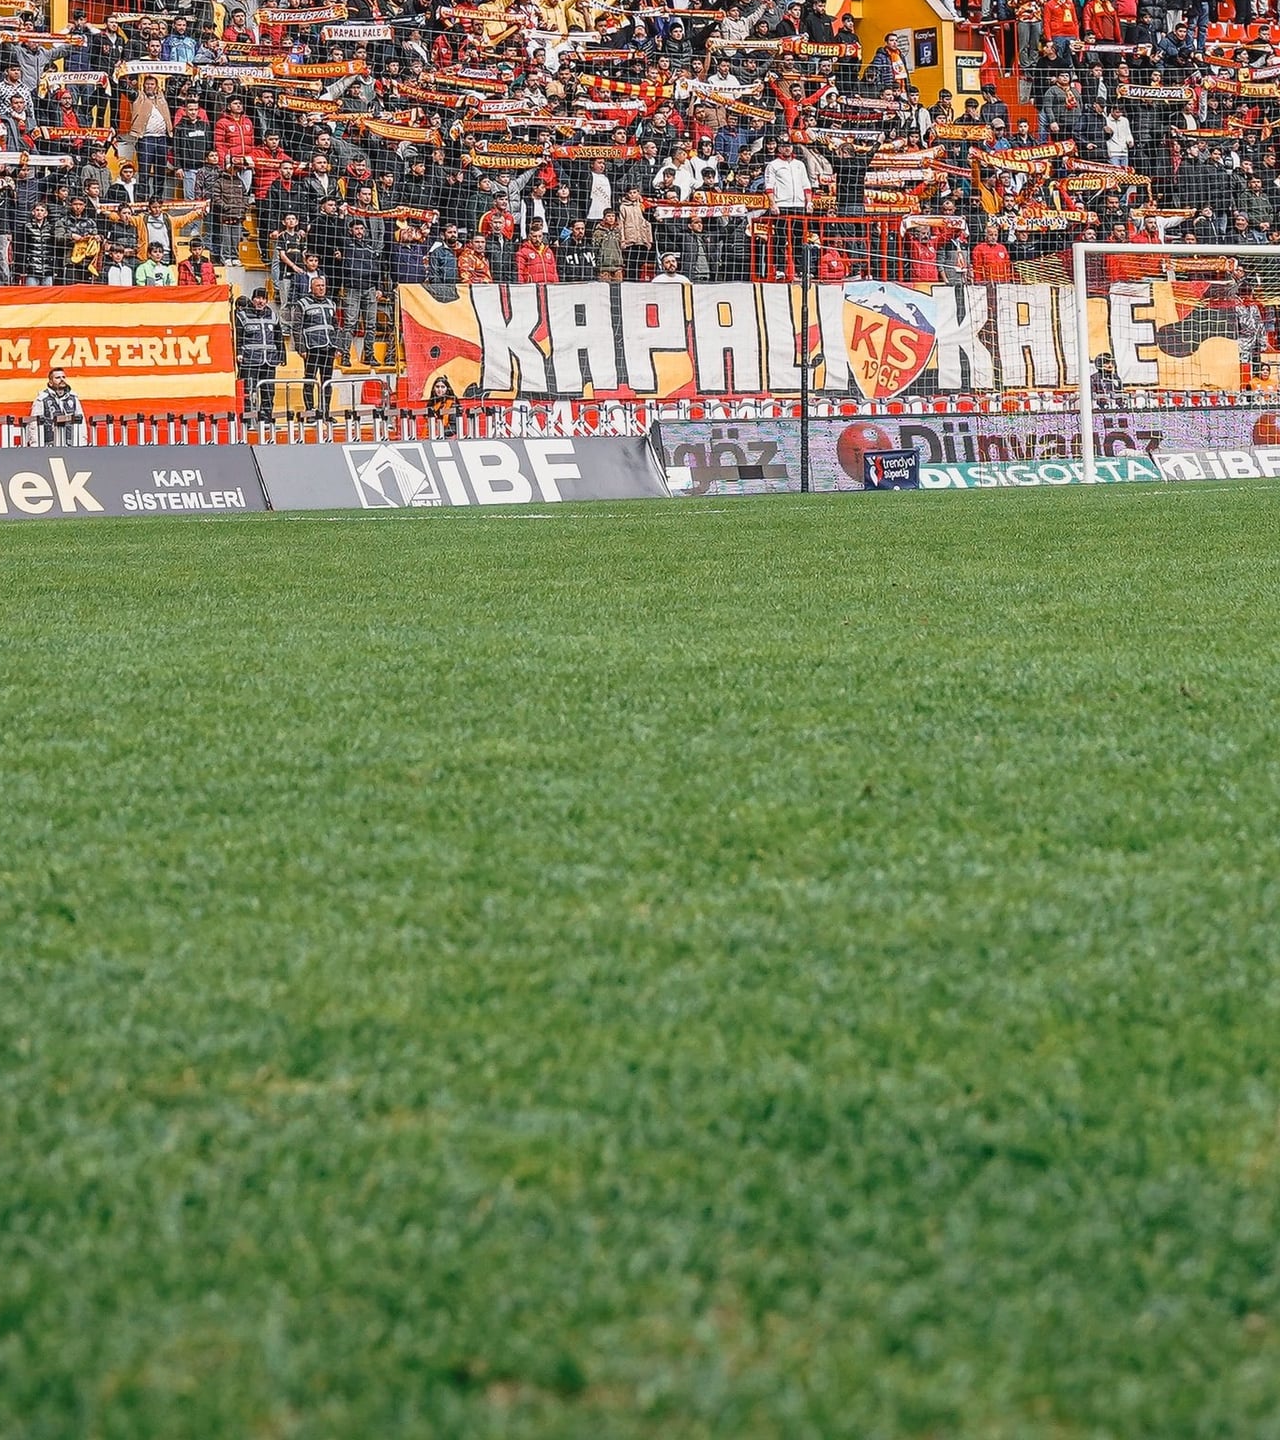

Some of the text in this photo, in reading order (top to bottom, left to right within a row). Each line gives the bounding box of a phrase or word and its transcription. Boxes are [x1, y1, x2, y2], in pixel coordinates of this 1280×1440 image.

[273, 8, 332, 22] KAYSERİSPOR
[333, 28, 382, 40] KAPALI KALE
[800, 44, 839, 56] SOLDIER
[130, 64, 183, 73] KAYSERİSPOR
[291, 64, 347, 74] KAYSERİSPOR
[1130, 87, 1185, 99] KAYSERİSPOR
[288, 99, 338, 113] KAYSERİSPOR
[50, 128, 108, 141] KAPALI KALE
[488, 143, 544, 155] KAYSERİSPOR
[573, 146, 623, 159] KAYSERİSPOR
[1014, 148, 1056, 161] SOLDIER
[473, 155, 538, 169] KAYSERİSPOR
[1068, 178, 1102, 191] SOLDIER
[712, 193, 764, 207] KAYSERİSPOR
[472, 282, 850, 394] KAPALI
[849, 315, 918, 370] KS
[48, 329, 212, 370] ZAFERİM
[862, 361, 902, 391] 1966
[882, 456, 917, 472] trendyol
[151, 469, 204, 489] KAPI
[122, 486, 246, 511] SİSTEMLERİ
